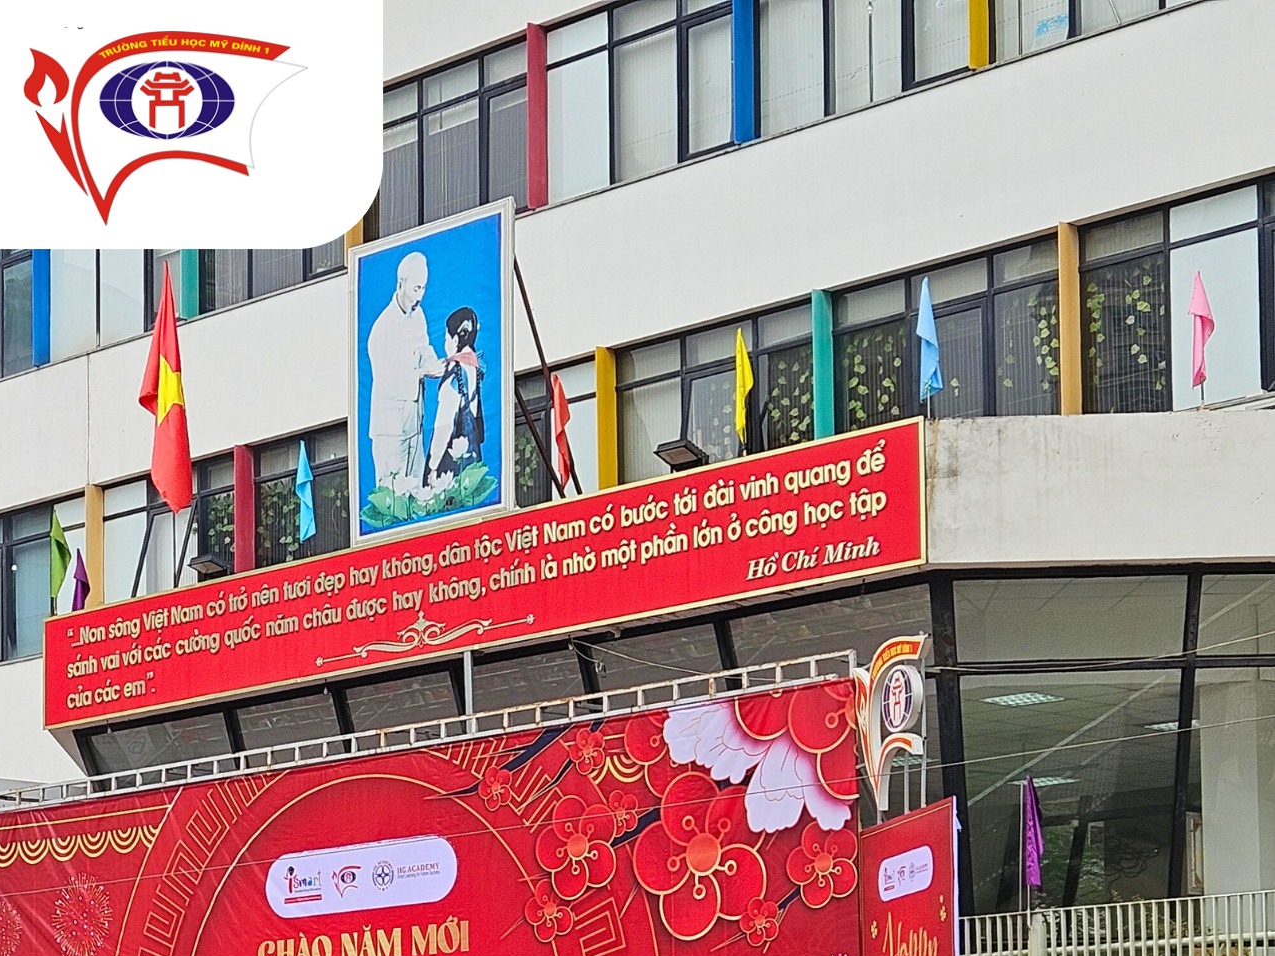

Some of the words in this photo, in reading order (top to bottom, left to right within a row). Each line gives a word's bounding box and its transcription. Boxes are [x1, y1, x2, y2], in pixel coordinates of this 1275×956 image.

[109, 616, 141, 638] sông
[142, 608, 170, 634] Việt
[170, 604, 203, 626] Nam
[206, 590, 226, 617] có
[229, 586, 248, 612] trở
[251, 583, 279, 608] nên
[283, 576, 311, 601] tươi
[314, 571, 346, 597] đẹp
[349, 563, 379, 586] hay
[382, 552, 437, 579] không,
[439, 542, 472, 568] dân
[475, 534, 503, 563] tộc
[505, 524, 539, 555] Việt
[543, 518, 586, 545] Nam
[589, 503, 615, 535] có
[620, 494, 669, 527] bước
[674, 487, 697, 516] tới
[703, 479, 735, 509] đài
[739, 473, 779, 501] vinh
[784, 459, 851, 495] quang
[856, 439, 886, 475] để
[745, 551, 779, 581] Hồ
[781, 546, 818, 574] Chí
[822, 535, 880, 566] Minh
[67, 653, 98, 679] sánh
[100, 651, 121, 671] vai
[122, 644, 142, 668] với
[144, 636, 173, 662] các
[175, 629, 221, 655] cường
[224, 615, 262, 650] quốc
[265, 613, 300, 638] năm
[303, 603, 342, 631] châu
[346, 597, 388, 622] được
[392, 588, 424, 613] hay
[428, 577, 486, 603] không,
[489, 558, 537, 591] chính
[540, 553, 559, 581] là
[562, 545, 596, 577] nhờ
[601, 539, 638, 569] một
[640, 522, 689, 565] phần
[693, 519, 724, 549] lớn
[727, 512, 742, 542] ở
[745, 508, 798, 537] công
[803, 499, 845, 529] học
[849, 487, 888, 522] tập
[67, 681, 92, 710] của
[94, 677, 122, 704] các
[407, 861, 440, 874] ACADEMY
